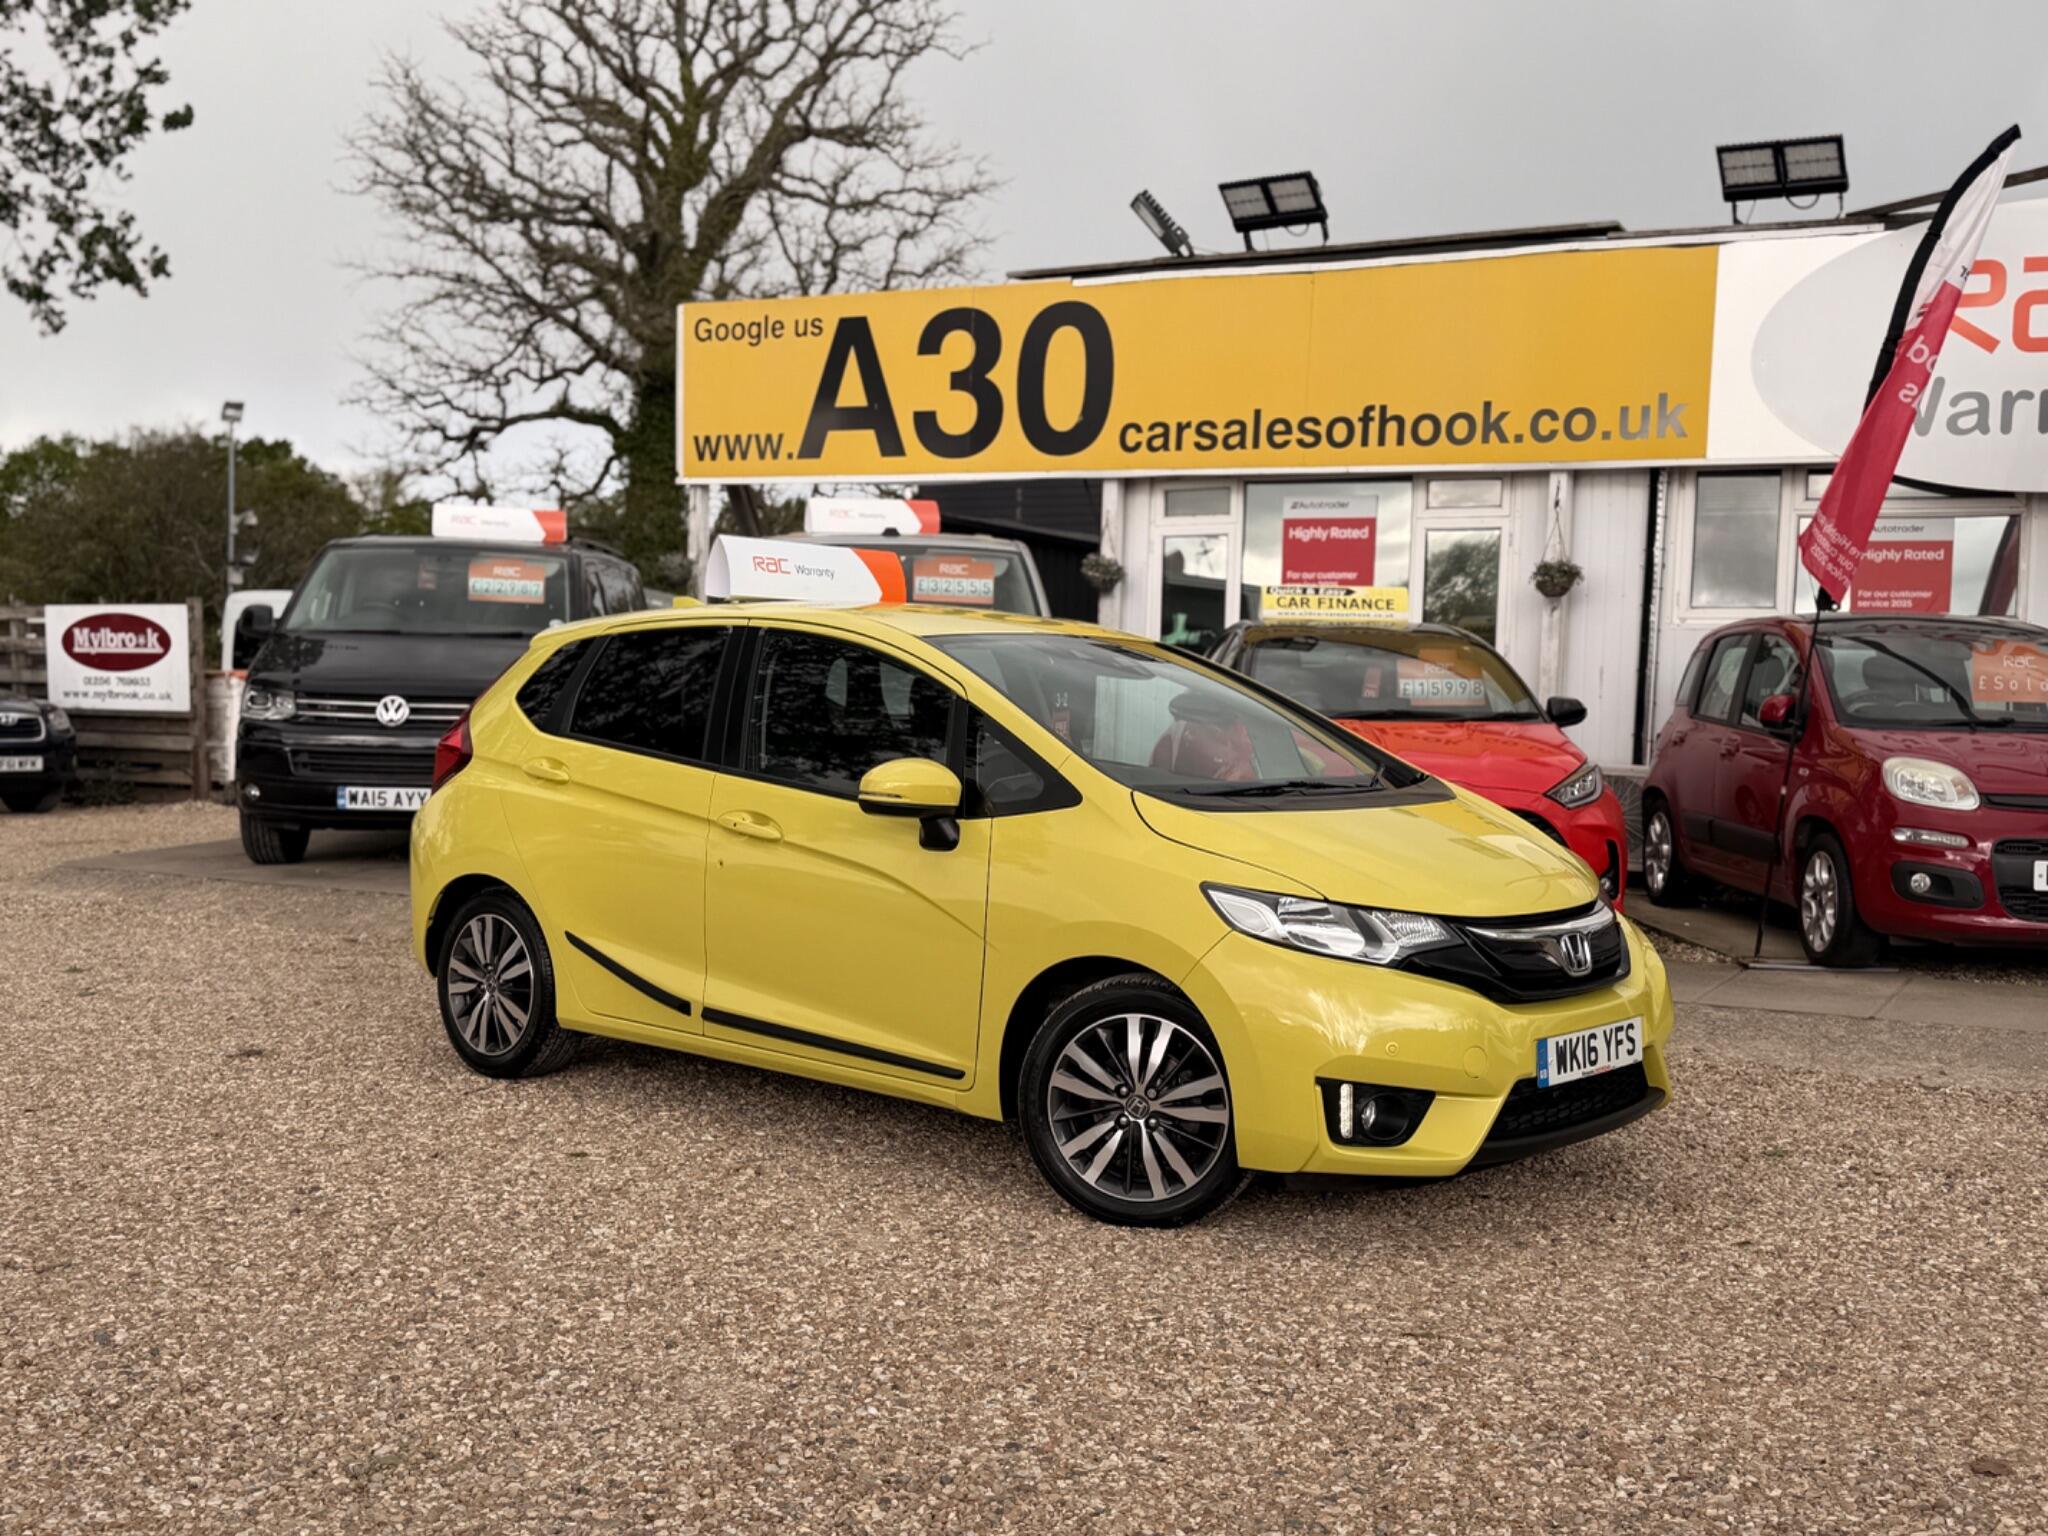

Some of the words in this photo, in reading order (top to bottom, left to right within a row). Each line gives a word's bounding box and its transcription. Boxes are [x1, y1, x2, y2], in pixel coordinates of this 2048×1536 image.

[694, 314, 785, 347] Google
[794, 317, 824, 338] us
[1288, 526, 1329, 542] Highly
[1330, 526, 1369, 540] Rated
[1861, 549, 1901, 562] Highly
[1904, 549, 1944, 561] Rated
[794, 564, 835, 580] Warranty
[1287, 570, 1300, 580] For
[1302, 572, 1316, 580] our
[1317, 571, 1358, 580] customer
[1857, 590, 1872, 598] For
[1890, 590, 1932, 598] customer
[1276, 596, 1311, 609] CAR
[1317, 597, 1395, 610] FINANCE
[1857, 599, 1889, 607] service
[1891, 599, 1912, 607] 2025
[1402, 682, 1482, 697] £15998
[348, 790, 388, 806] WA15
[394, 791, 428, 807] AYY
[1556, 1032, 1599, 1075] WK16
[1603, 1023, 1636, 1062] YFS
